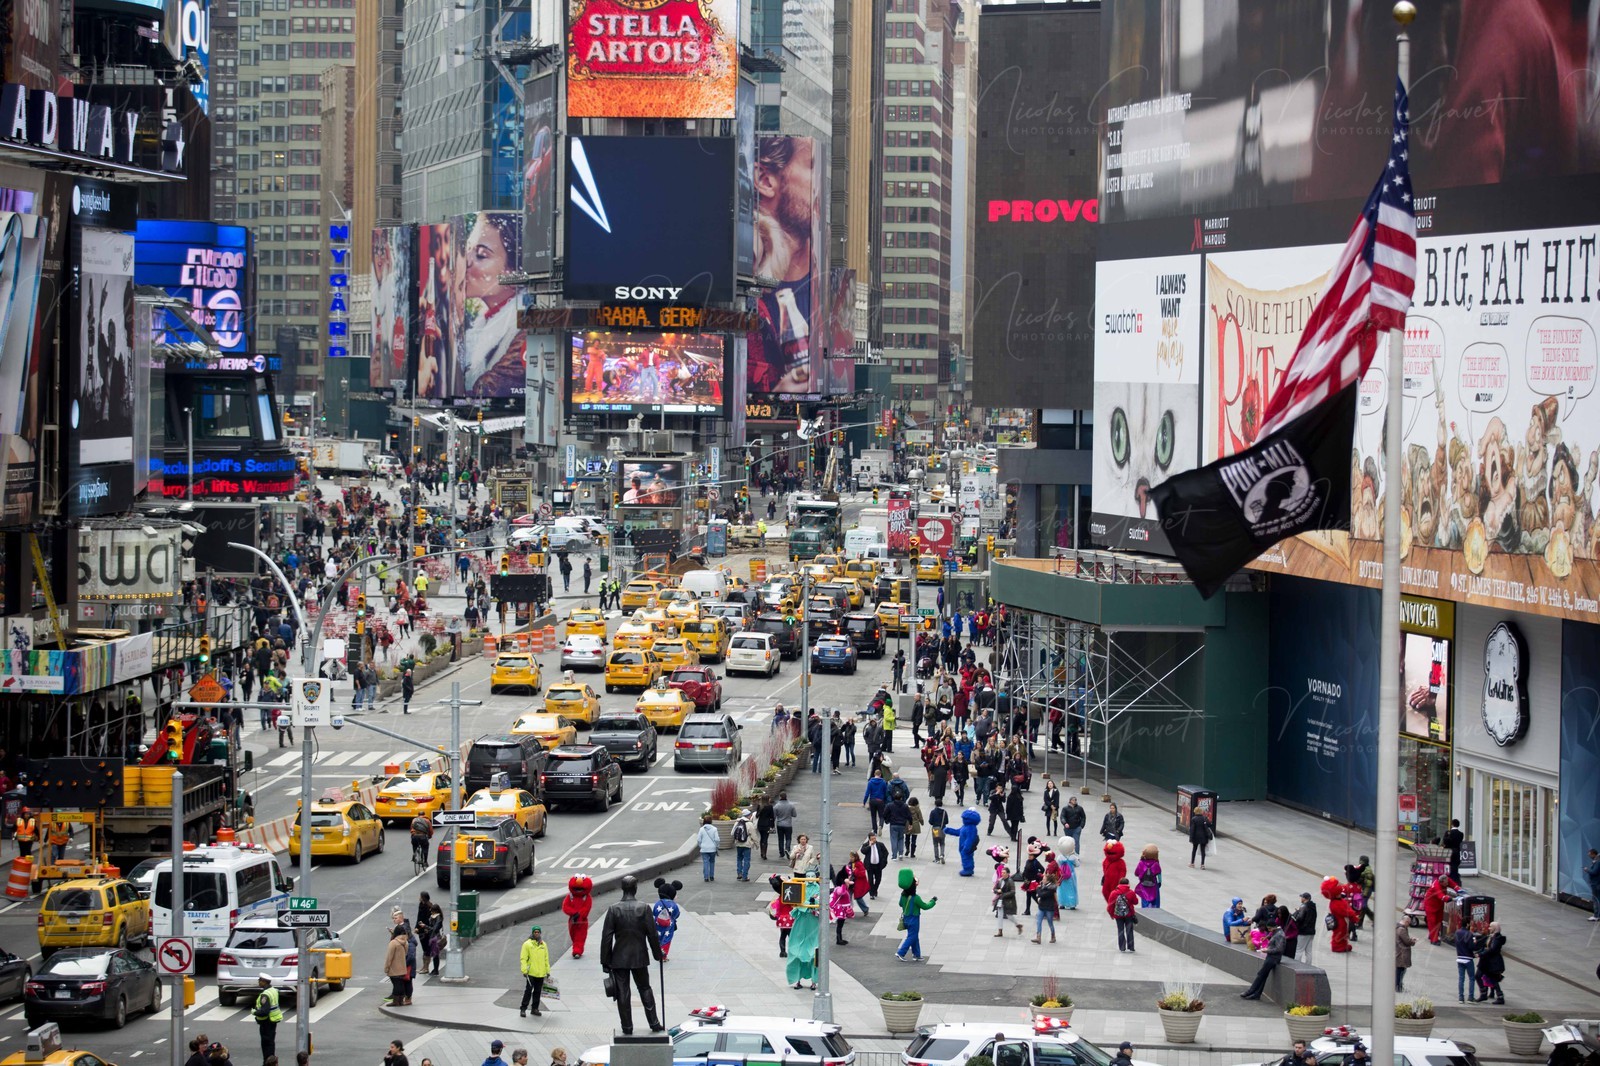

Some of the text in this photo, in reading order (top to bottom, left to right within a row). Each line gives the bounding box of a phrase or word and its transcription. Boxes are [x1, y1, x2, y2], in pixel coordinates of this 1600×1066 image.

[588, 14, 698, 37] STELLA
[586, 41, 700, 63] ARTOIS
[1107, 105, 1128, 124] NATHANIEL
[1152, 98, 1161, 115] THE
[1161, 95, 1174, 114] NIGHT
[1174, 92, 1192, 112] SWEATS
[1106, 176, 1120, 194] LISTEN
[1127, 173, 1140, 191] APPLE
[1140, 172, 1154, 189] MUSIC
[81, 189, 111, 215] sunglass hut
[1413, 197, 1437, 211] RRIOTT
[1204, 217, 1230, 230] MARRIOTT
[1416, 215, 1432, 228] QUIS
[1204, 234, 1226, 245] MARQUIS
[1424, 233, 1600, 311] BIG, FAT HIT
[1160, 274, 1186, 295] ALWAYS
[615, 286, 682, 300] SONY
[1160, 298, 1181, 318] WANT
[1226, 287, 1318, 335] SOMETHIN
[1105, 309, 1137, 334] swatch
[1552, 329, 1583, 344] FUNNIEST
[1542, 348, 1580, 362] THING SINCE
[219, 358, 248, 370] NEWS
[1478, 357, 1501, 371] HOTTEST
[1530, 366, 1542, 380] THE
[1542, 366, 1557, 380] BOOK
[1462, 374, 1479, 388] TICKET
[1480, 393, 1493, 402] TODAY
[1219, 440, 1304, 508] POW MIA
[211, 479, 239, 494] lifts
[888, 506, 910, 522] JERSEY
[890, 520, 907, 533] BOYS
[1129, 526, 1145, 541] swatch
[1266, 525, 1279, 534] ARE
[1280, 521, 1295, 530] NOT
[1458, 574, 1467, 592] ST.
[1467, 576, 1491, 598] JAMES
[1492, 578, 1526, 604] THEATRE,
[1526, 585, 1538, 604] 246
[1539, 585, 1548, 605] W.
[1574, 591, 1598, 613] between
[1400, 601, 1440, 629] NVICTA
[1307, 678, 1342, 698] VORNADO
[292, 899, 299, 908] W
[1471, 905, 1488, 914] JERSEY
